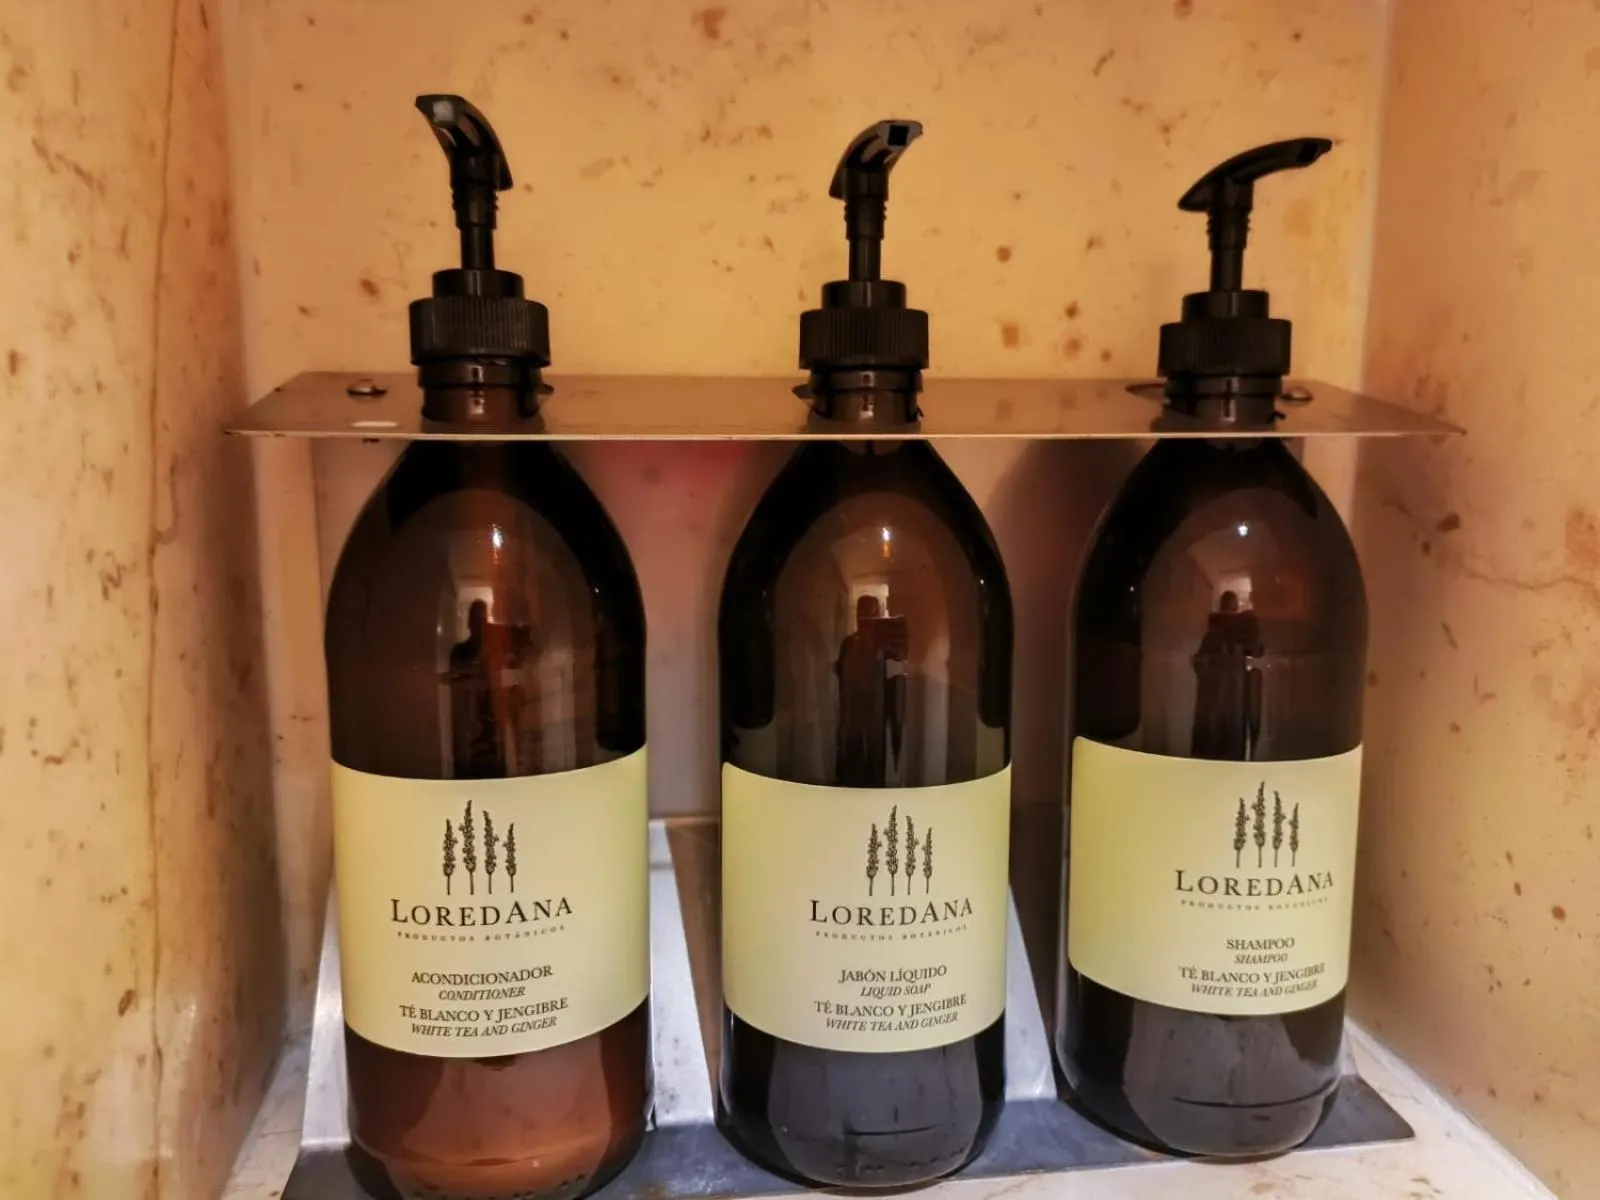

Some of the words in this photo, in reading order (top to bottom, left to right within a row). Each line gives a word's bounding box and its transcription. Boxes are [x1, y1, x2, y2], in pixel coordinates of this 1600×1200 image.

[1175, 870, 1334, 896] LOREDANA
[391, 897, 573, 926] LOREDANA
[810, 898, 973, 926] LOREDANA
[1226, 937, 1294, 950] SHAMPOO
[1234, 953, 1288, 964] SHAMPOO
[412, 965, 552, 985] ACONDICIONADOR
[838, 969, 885, 983] JABÓN
[890, 965, 947, 982] LÍQUIDO
[1178, 966, 1197, 979] TÉ
[1202, 969, 1260, 983] BLANCO
[1263, 972, 1272, 982] Y
[1274, 963, 1325, 985] JENGIBRE
[438, 986, 526, 1000] CONDITIONER
[860, 986, 901, 999] LIQUID
[903, 983, 931, 996] SOAP
[1192, 984, 1232, 996] WHITE
[1236, 988, 1257, 997] TEA
[1261, 985, 1283, 996] AND
[1284, 980, 1318, 994] GINGER
[399, 1004, 416, 1018] TÉ
[420, 1008, 479, 1022] BLANCO
[484, 1009, 493, 1020] Y
[496, 997, 568, 1023] JENGIBRE
[814, 1000, 832, 1013] TÉ
[836, 1004, 894, 1017] BLANCO
[898, 1005, 907, 1016] Y
[909, 994, 967, 1018] JENGIBRE
[412, 1023, 451, 1037] WHITE
[455, 1027, 478, 1037] TEA
[481, 1025, 508, 1036] AND
[511, 1016, 557, 1033] GINGER
[826, 1018, 866, 1031] WHITE
[871, 1021, 892, 1031] TEA
[895, 1019, 919, 1030] AND
[921, 1012, 958, 1028] GINGER
